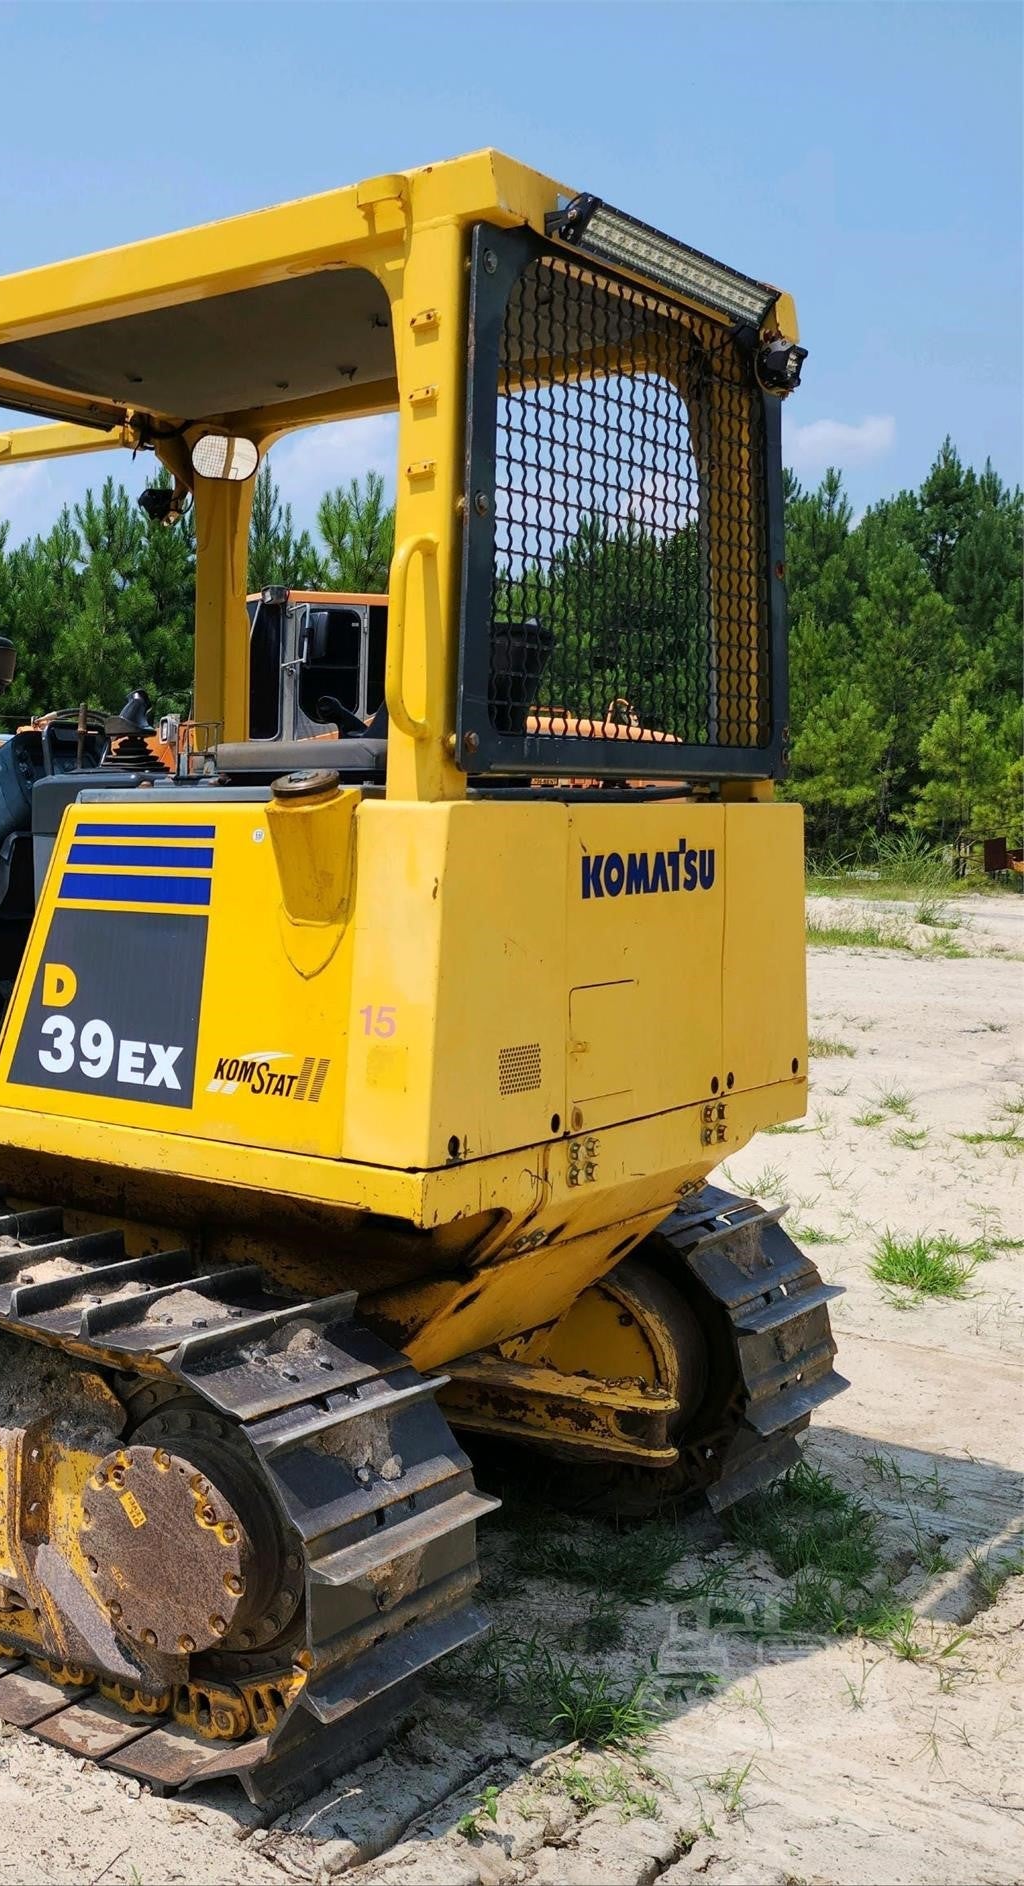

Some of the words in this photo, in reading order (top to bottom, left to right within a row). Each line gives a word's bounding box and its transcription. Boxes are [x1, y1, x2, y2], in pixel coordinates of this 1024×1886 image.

[582, 839, 715, 899] KOMATSU
[42, 963, 77, 1008] D
[359, 1004, 397, 1039] 15
